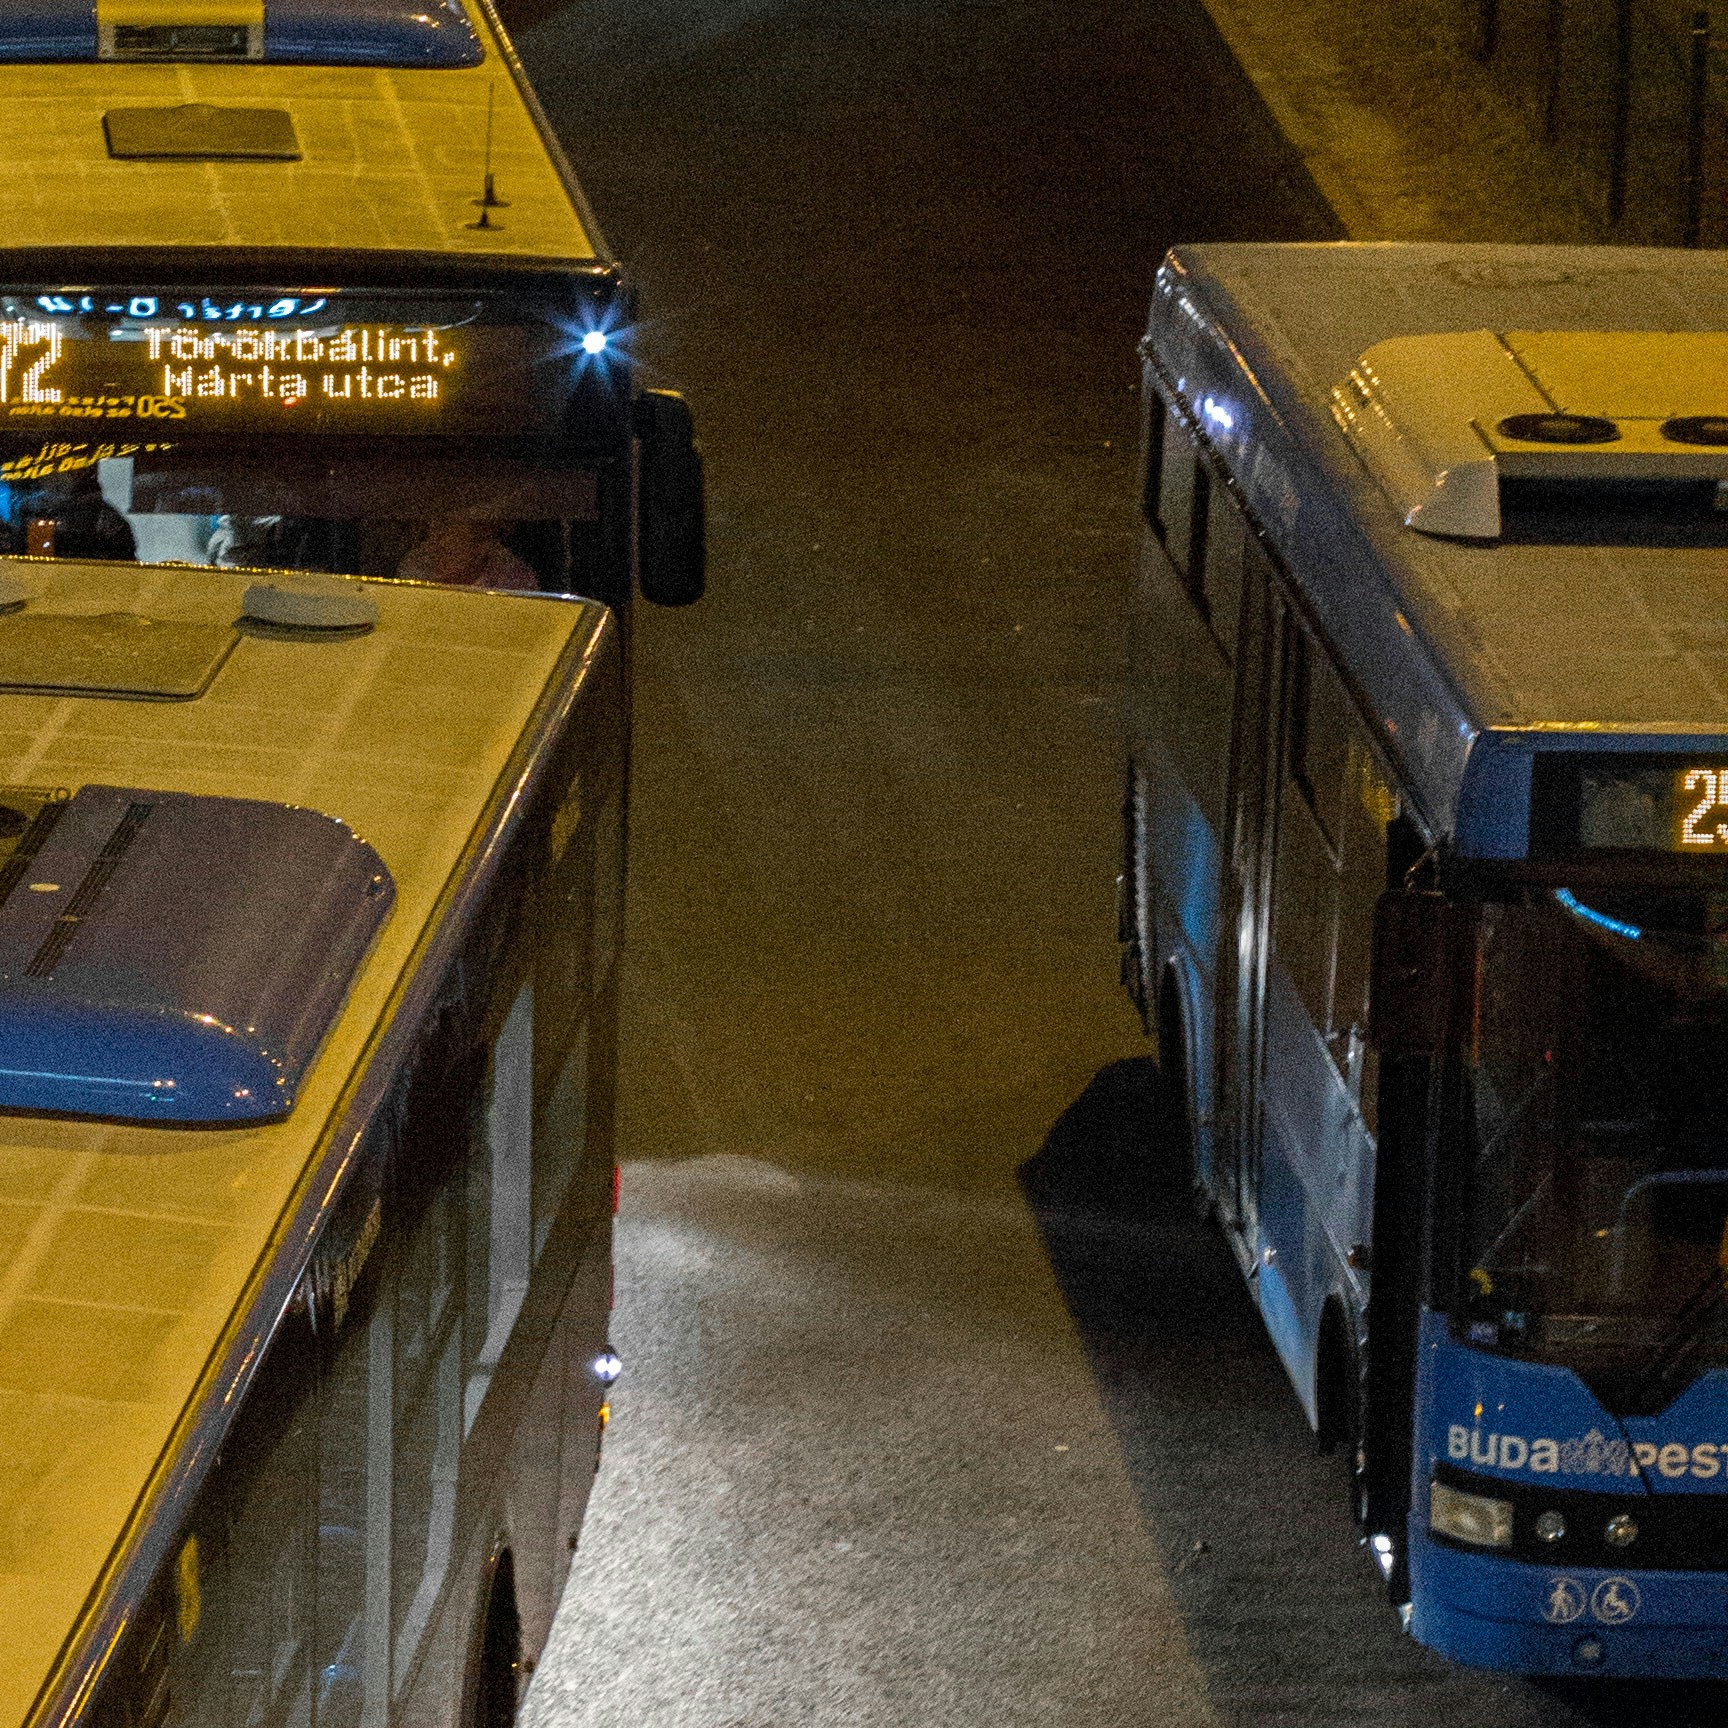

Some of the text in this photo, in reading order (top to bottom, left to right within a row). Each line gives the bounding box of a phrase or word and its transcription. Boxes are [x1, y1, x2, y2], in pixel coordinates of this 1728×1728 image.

[144, 326, 455, 366] Törökbálint,
[165, 364, 438, 399] Márta utca
[1683, 770, 1728, 845] 2
